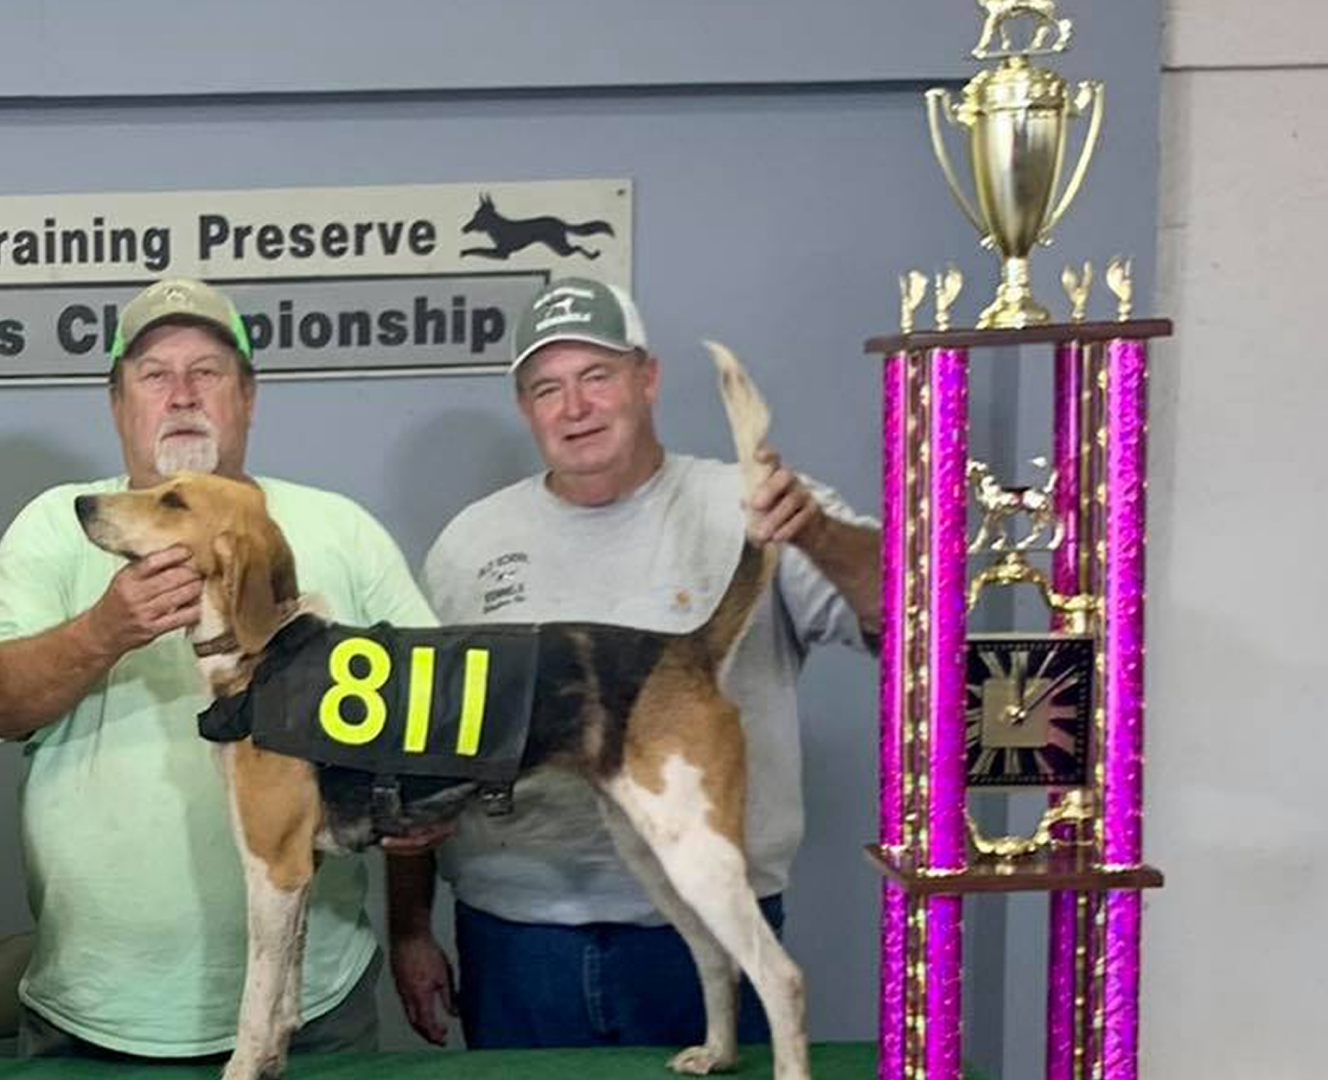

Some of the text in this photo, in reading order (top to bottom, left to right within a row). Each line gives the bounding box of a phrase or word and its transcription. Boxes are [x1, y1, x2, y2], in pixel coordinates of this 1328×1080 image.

[198, 213, 437, 260] Preserve
[57, 295, 506, 355] Chpionship
[318, 637, 490, 756] 811
